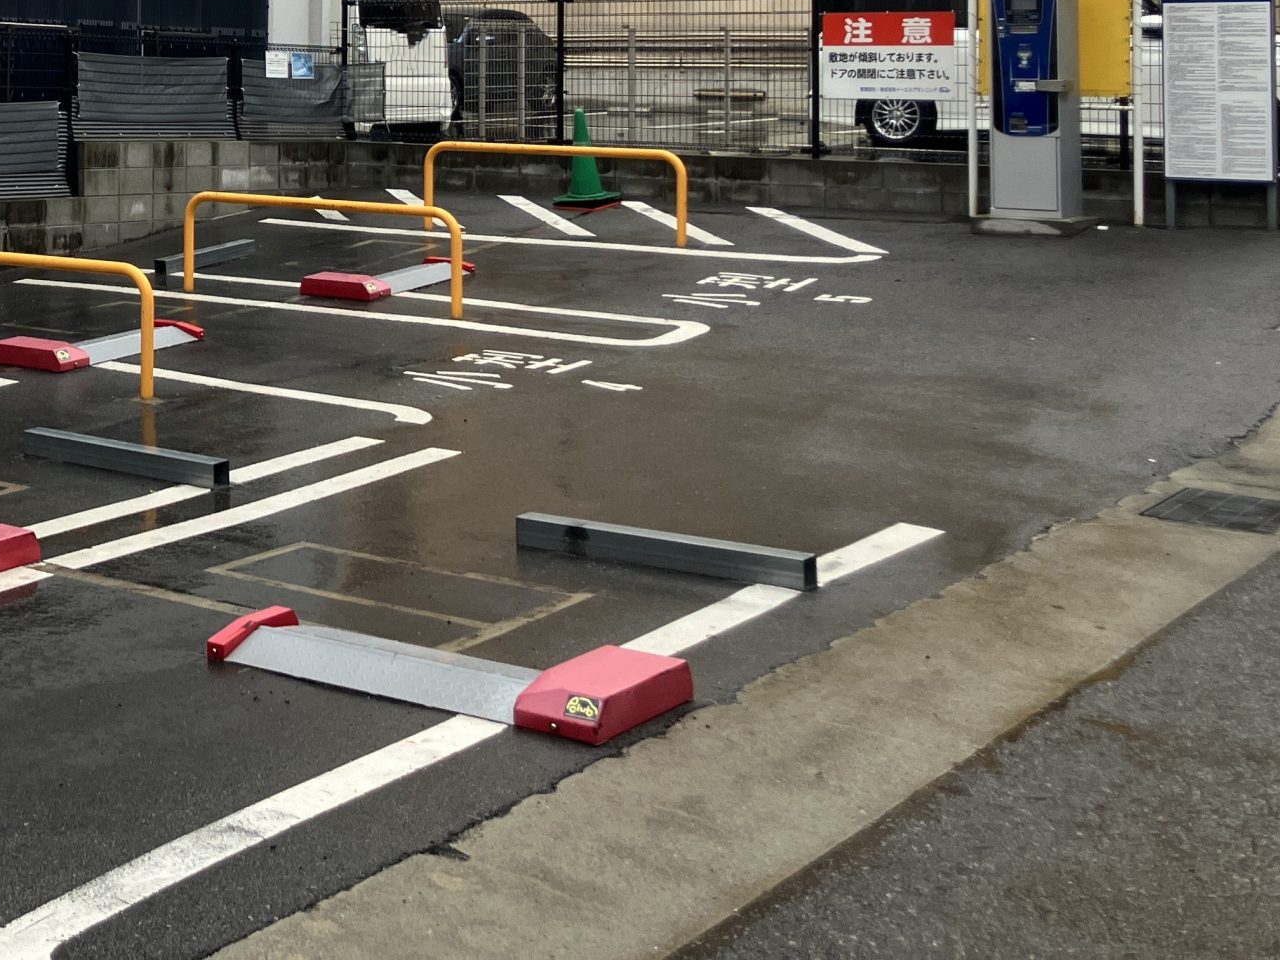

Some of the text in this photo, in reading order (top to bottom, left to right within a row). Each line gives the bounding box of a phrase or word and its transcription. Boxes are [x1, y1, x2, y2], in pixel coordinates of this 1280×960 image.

[843, 17, 932, 44] 注意
[828, 51, 938, 64] 敷地が傾斜しております。
[830, 68, 950, 80] ドアの開閉にご注意下さい。
